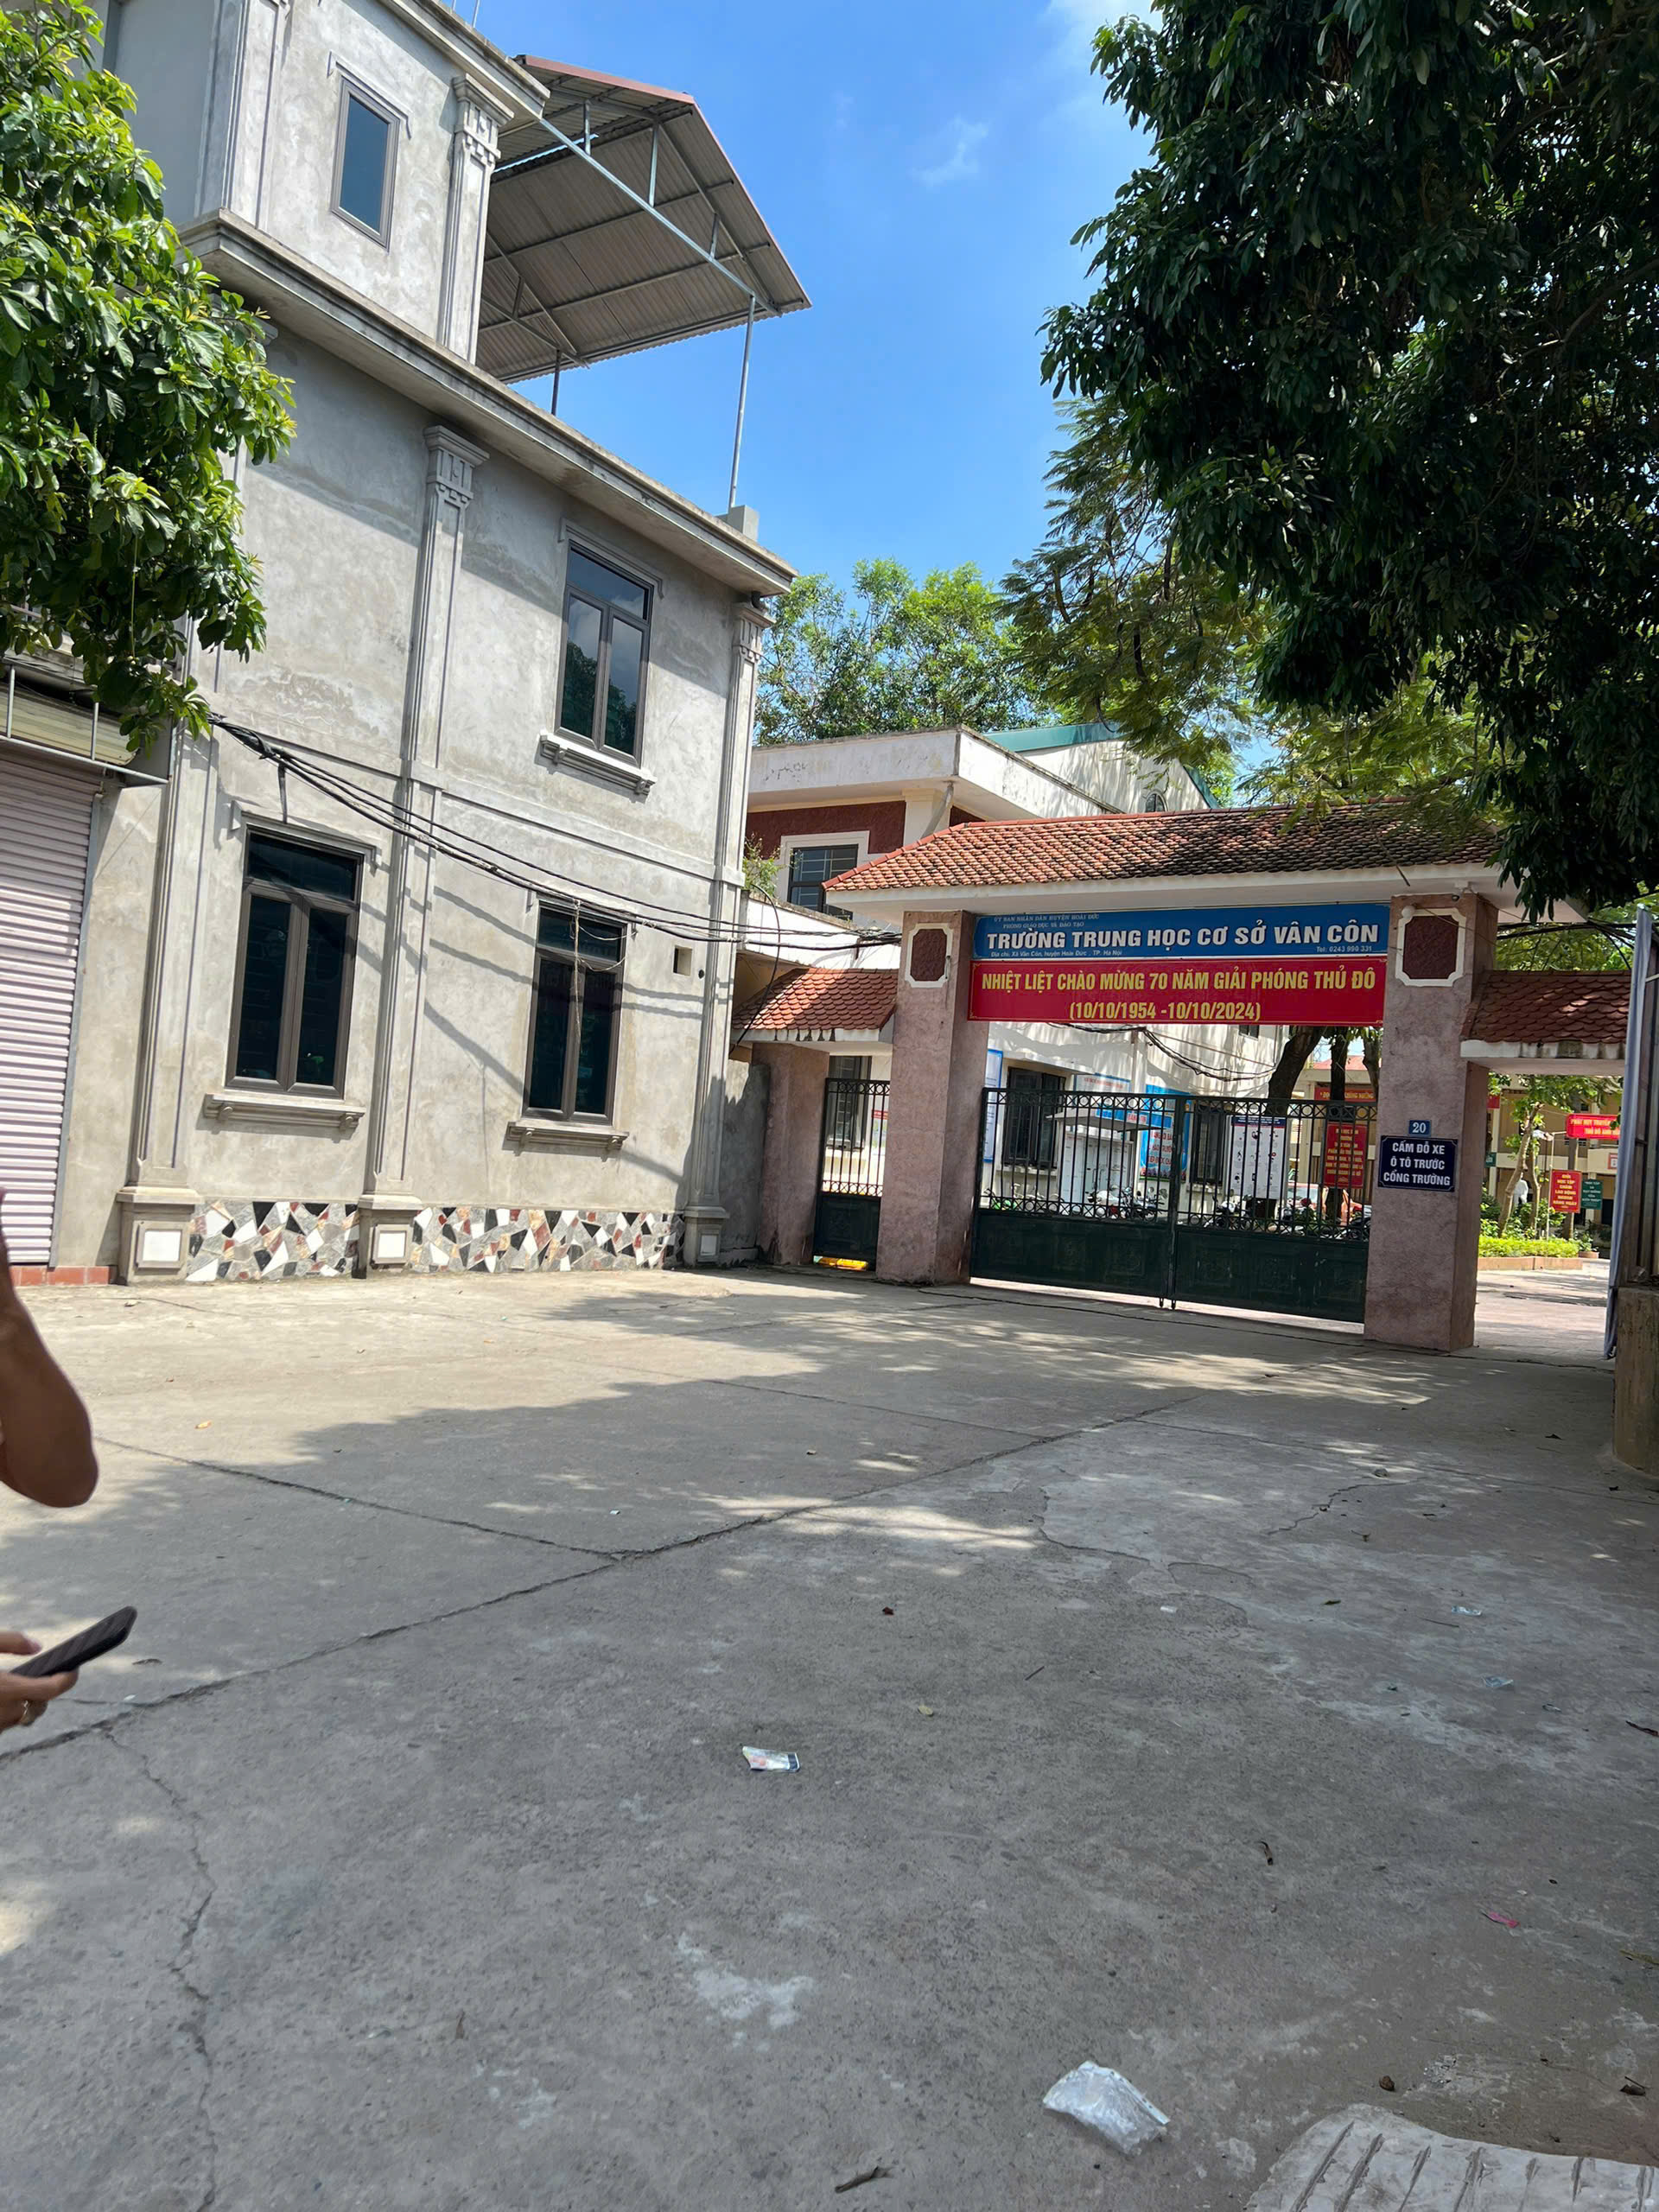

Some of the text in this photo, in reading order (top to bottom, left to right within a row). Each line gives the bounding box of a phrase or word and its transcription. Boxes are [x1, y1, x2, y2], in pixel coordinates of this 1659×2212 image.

[987, 918, 1379, 950] TRƯỜNG TRUNG HỌC CƠ SỞ VÂN CÔN
[982, 965, 1376, 993] NHIỆT LIỆT CHÀO MỪNG 70 NĂM GIẢI PHÓNG THỦ ĐÔ
[1070, 1001, 1156, 1020] (10/10/1954
[1412, 1122, 1427, 1134] 20
[1392, 1140, 1445, 1154] CẤM ĐỖ XE
[1390, 1155, 1445, 1170] Ô TÔ TRƯỚC
[1383, 1169, 1451, 1185] CỔNG TRƯỜNG
